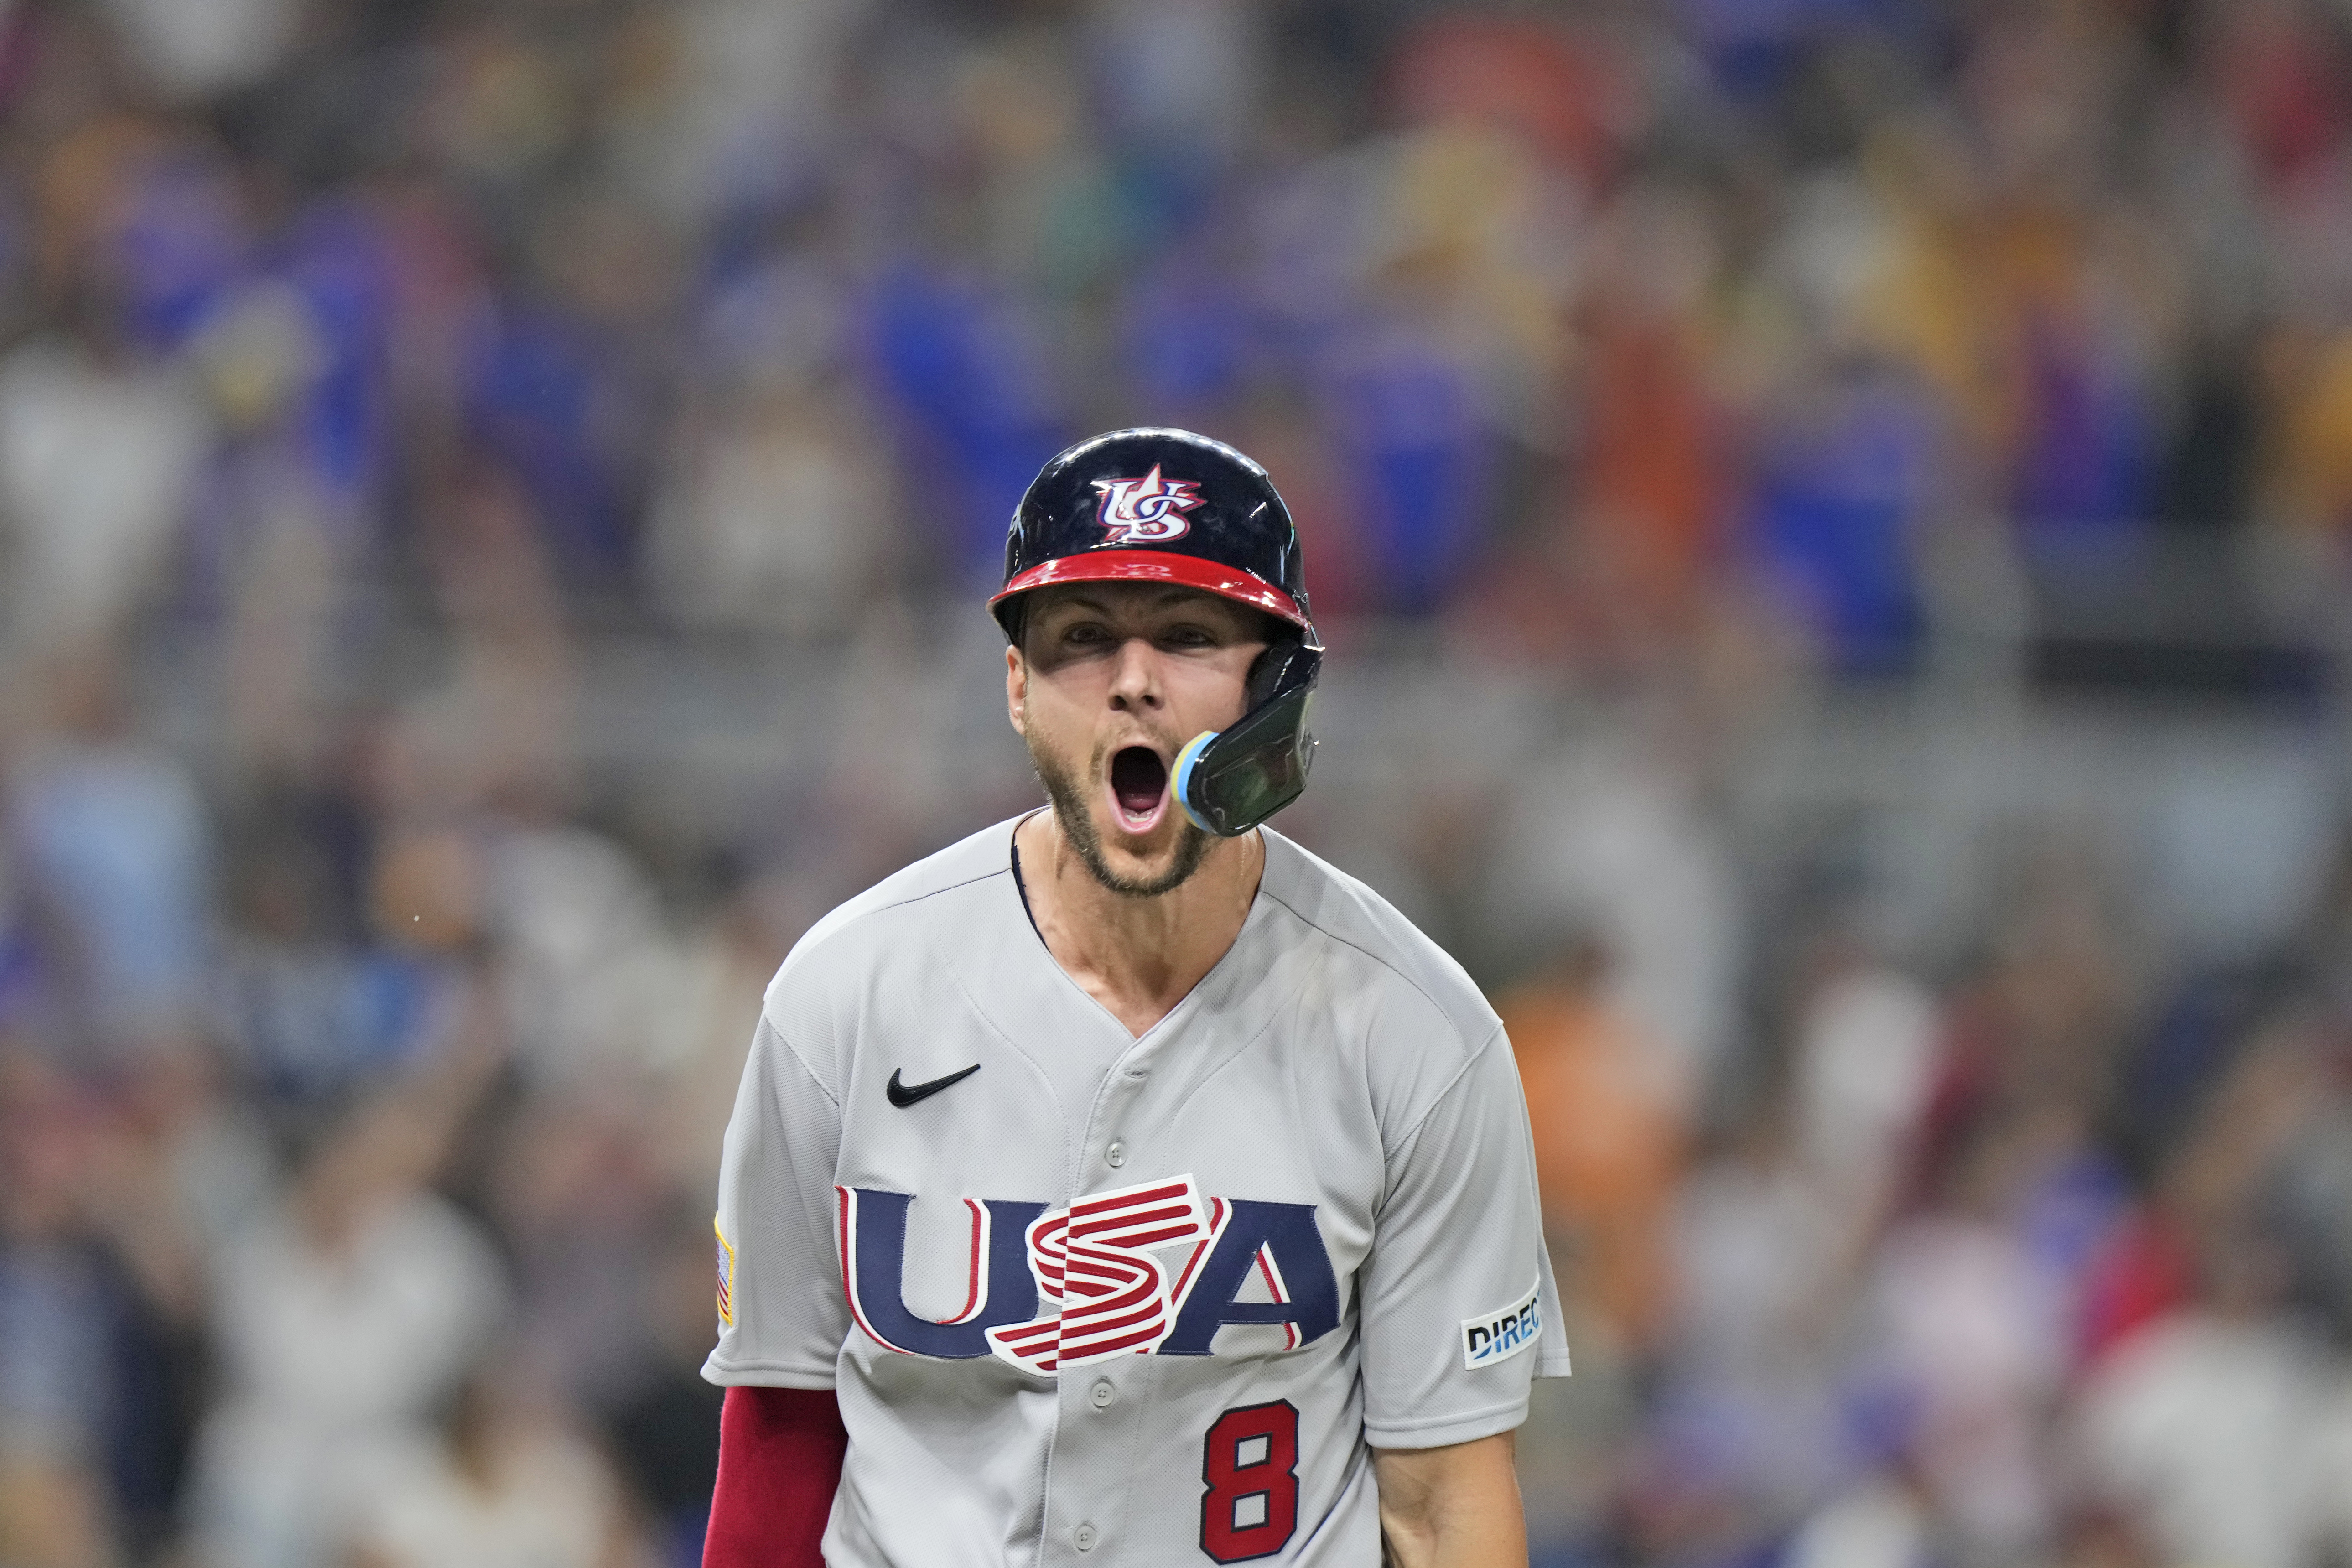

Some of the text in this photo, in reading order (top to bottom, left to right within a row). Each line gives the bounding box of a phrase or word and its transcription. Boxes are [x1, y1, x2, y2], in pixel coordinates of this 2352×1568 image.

[835, 1173, 1340, 1377] USA
[1468, 1290, 1541, 1360] DIREC
[1199, 1399, 1300, 1565] 8
